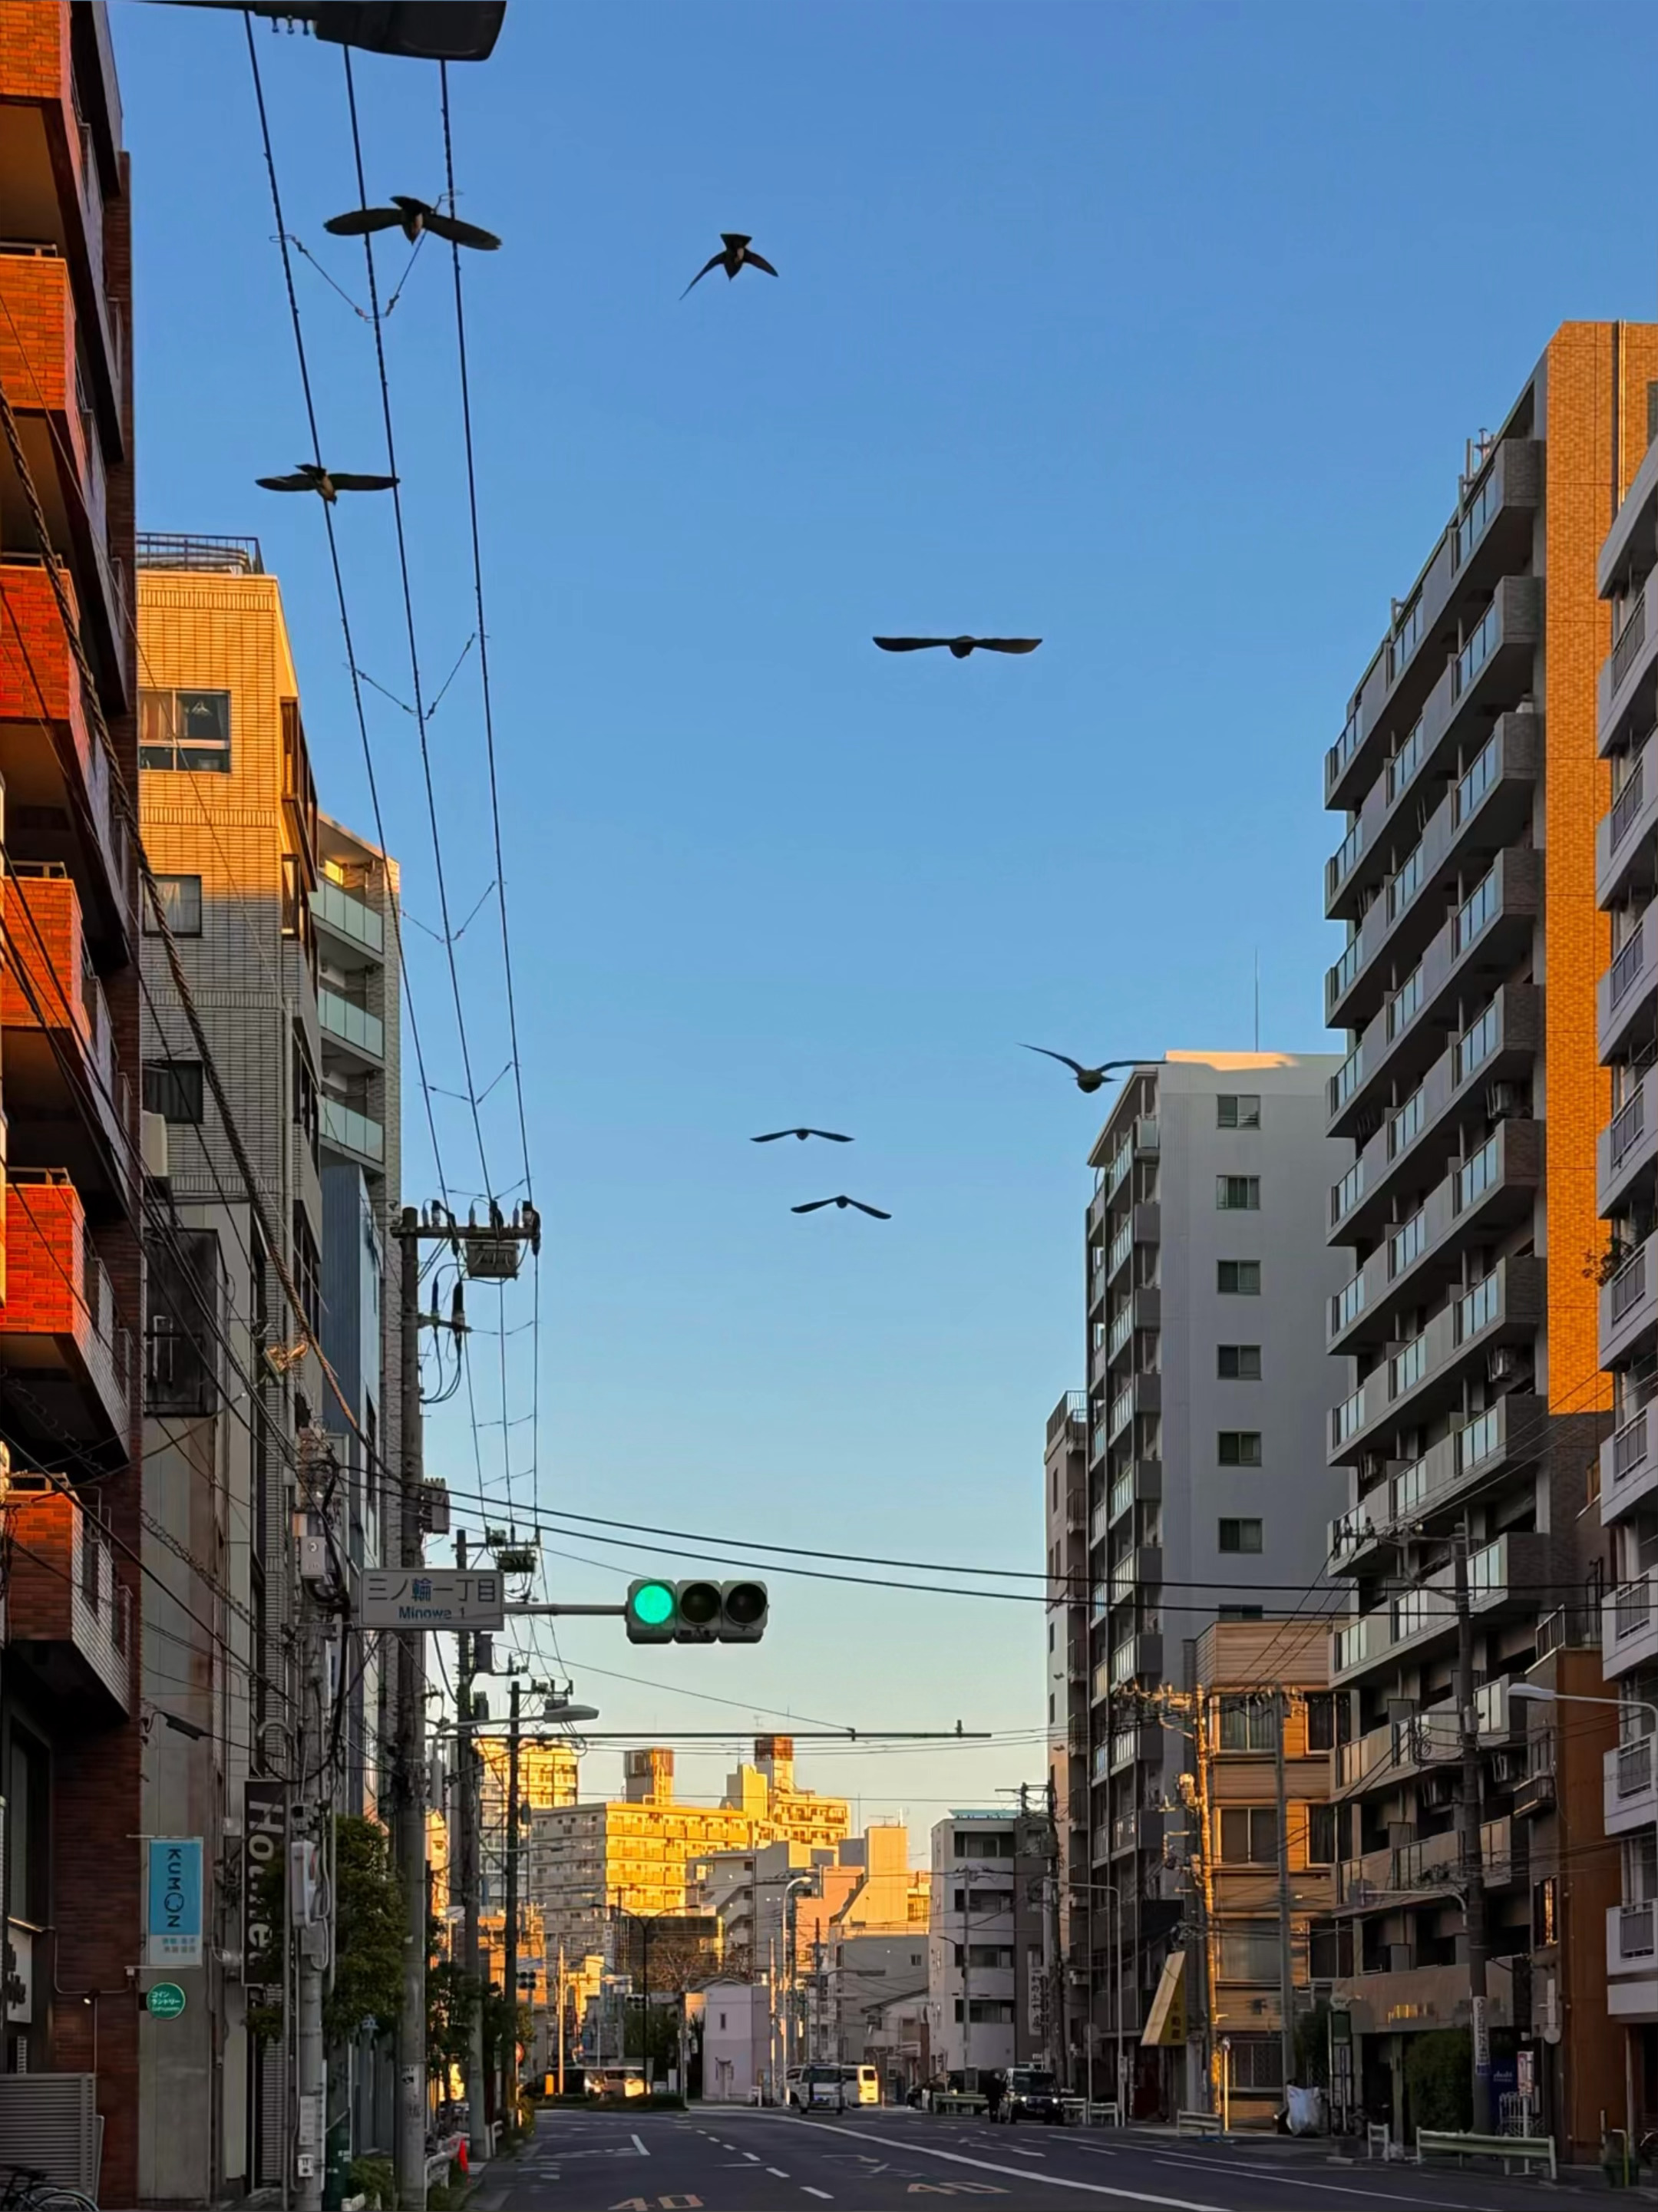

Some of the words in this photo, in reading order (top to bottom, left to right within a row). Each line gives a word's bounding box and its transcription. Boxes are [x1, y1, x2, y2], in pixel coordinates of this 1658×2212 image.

[368, 1577, 495, 1602] 三ノ輪一丁目
[399, 1606, 451, 1619] Minowa
[164, 1848, 184, 1927] KUMON
[607, 2194, 704, 2211] 40
